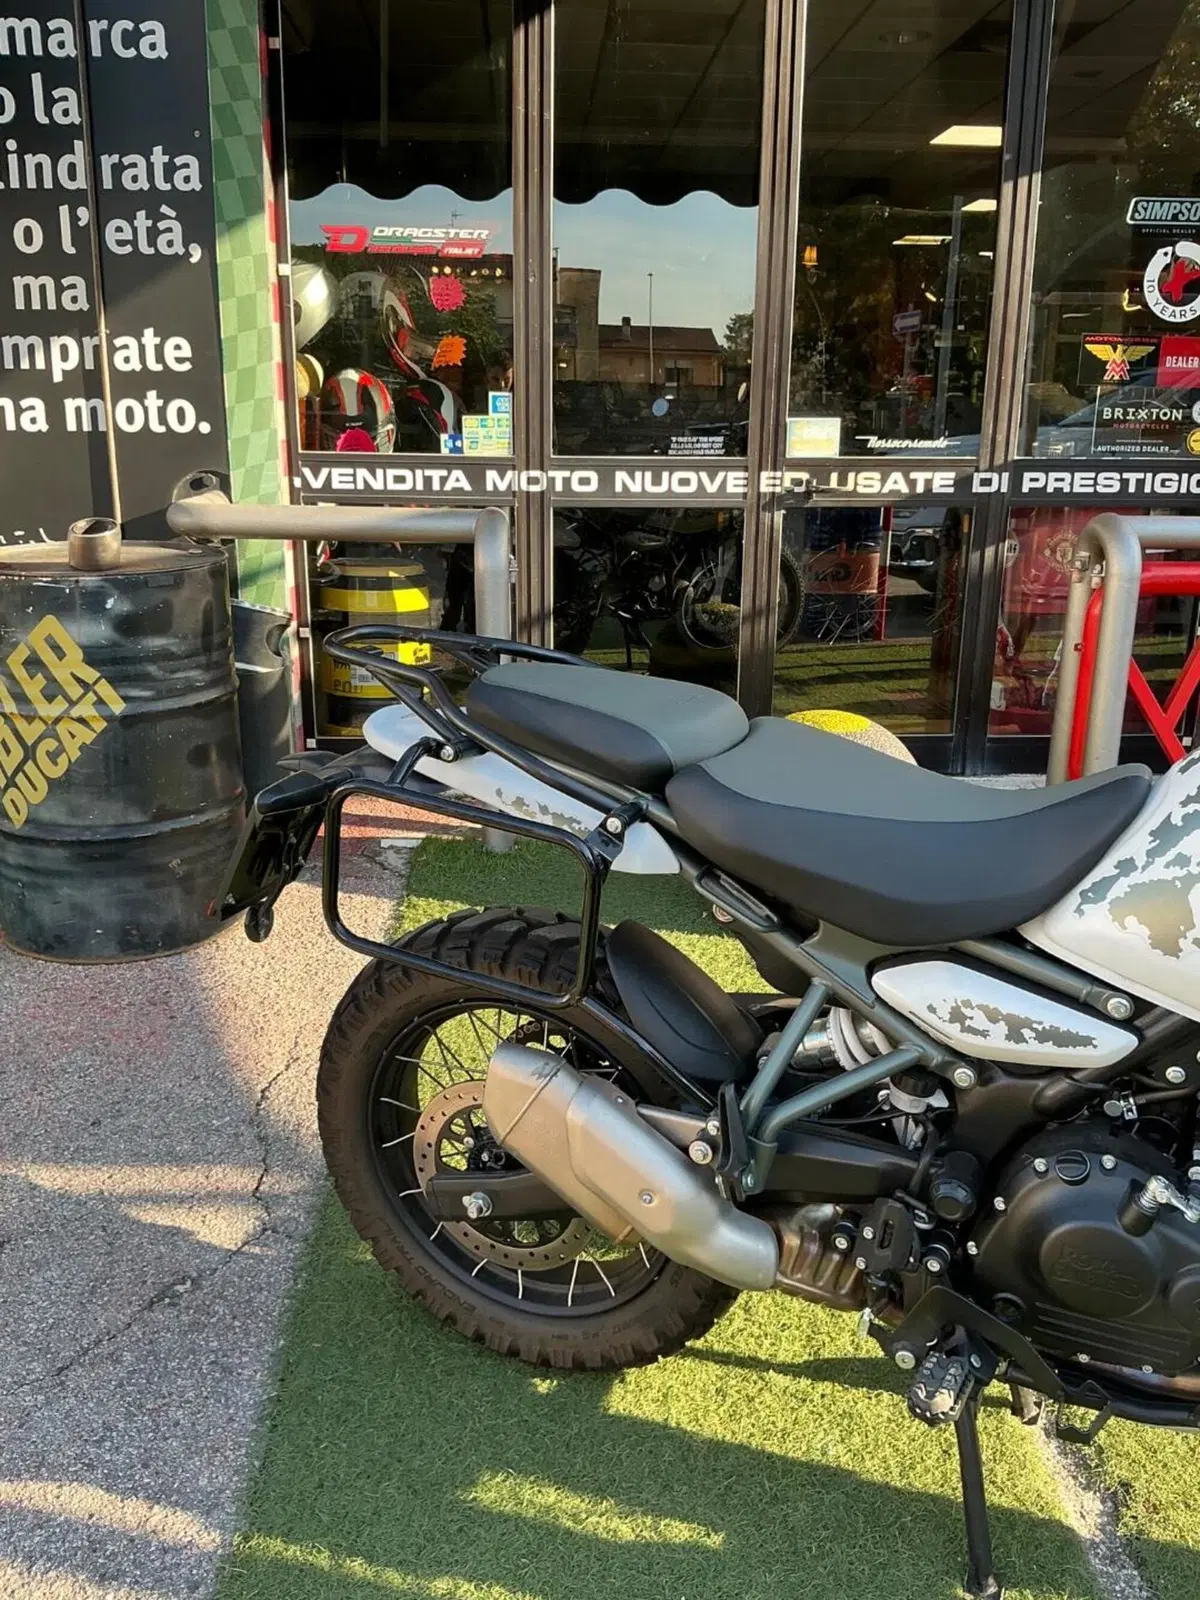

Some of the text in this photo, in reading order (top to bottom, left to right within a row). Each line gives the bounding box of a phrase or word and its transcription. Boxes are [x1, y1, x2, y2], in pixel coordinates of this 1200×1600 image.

[31, 72, 82, 126] la
[0, 139, 202, 192] indrata
[13, 217, 43, 255] o
[373, 226, 489, 240] DRAGSTER
[12, 274, 90, 312] ma
[1152, 297, 1198, 319] YEARS
[1165, 355, 1200, 369] DEALER
[64, 390, 212, 434] moto.
[1102, 407, 1183, 421] BRIXTON
[1096, 444, 1170, 453] AUTHORIZED DEALER
[301, 467, 472, 491] VENDITA
[486, 470, 598, 492] MOTO
[614, 471, 748, 493] NUOVE
[829, 472, 956, 494] USATE
[972, 472, 1010, 493] DI
[3, 677, 127, 830] DUCATI
